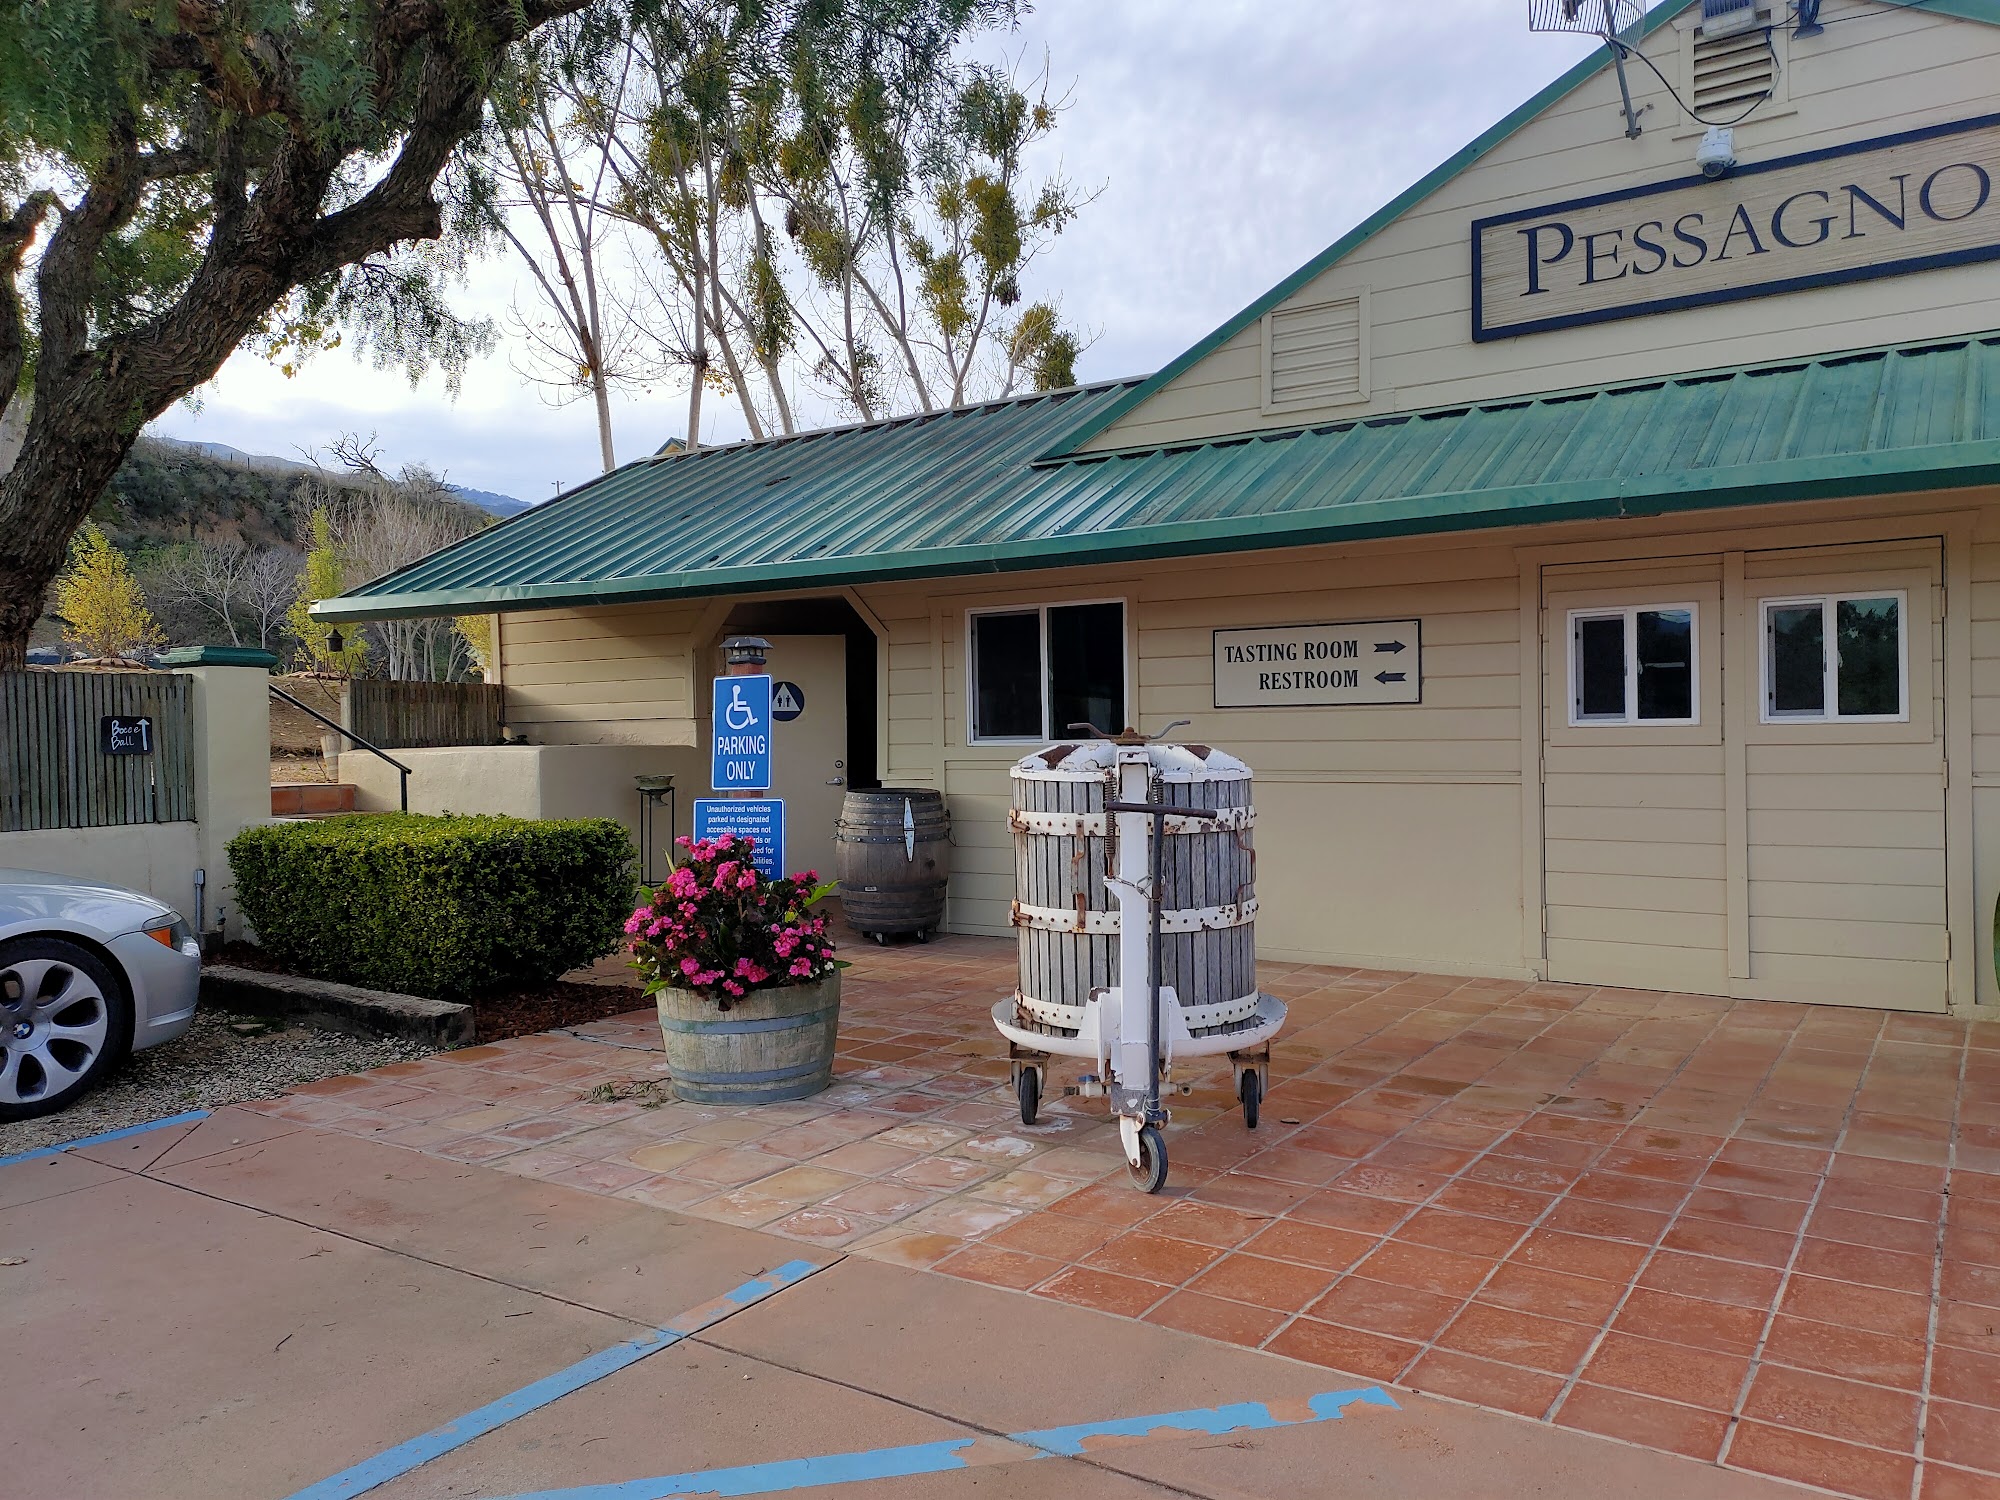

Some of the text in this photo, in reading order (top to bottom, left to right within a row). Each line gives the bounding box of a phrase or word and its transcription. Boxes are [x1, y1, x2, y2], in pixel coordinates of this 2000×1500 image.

[1516, 162, 1991, 297] PESSAGNO
[1224, 640, 1358, 663] TASTING ROOM
[1259, 670, 1358, 690] RESTROOM
[111, 720, 141, 737] Bocce
[111, 736, 134, 751] Ball
[717, 735, 766, 756] PARKING
[726, 760, 756, 781] ONLY
[706, 805, 771, 813] Unauthorized vehicles
[708, 816, 728, 824] parked
[736, 815, 770, 825] designated
[706, 826, 771, 835] accessible spaces not
[751, 857, 775, 866] bilities,
